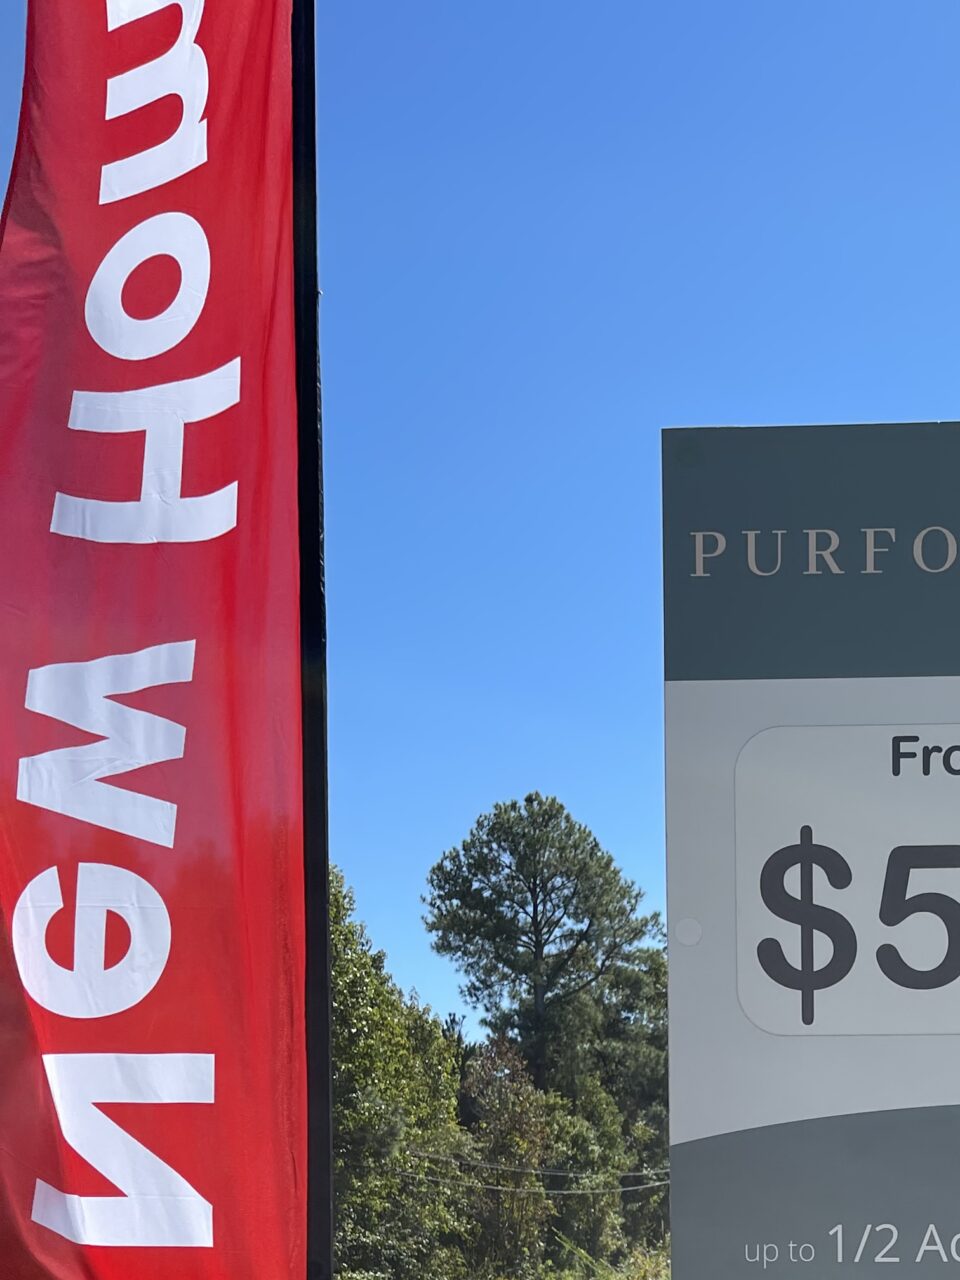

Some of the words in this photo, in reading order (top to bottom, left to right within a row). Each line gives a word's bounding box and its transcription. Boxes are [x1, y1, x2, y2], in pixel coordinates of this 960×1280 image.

[744, 1241, 780, 1269] up
[788, 1240, 816, 1263] to
[827, 1224, 900, 1263] 1/2
